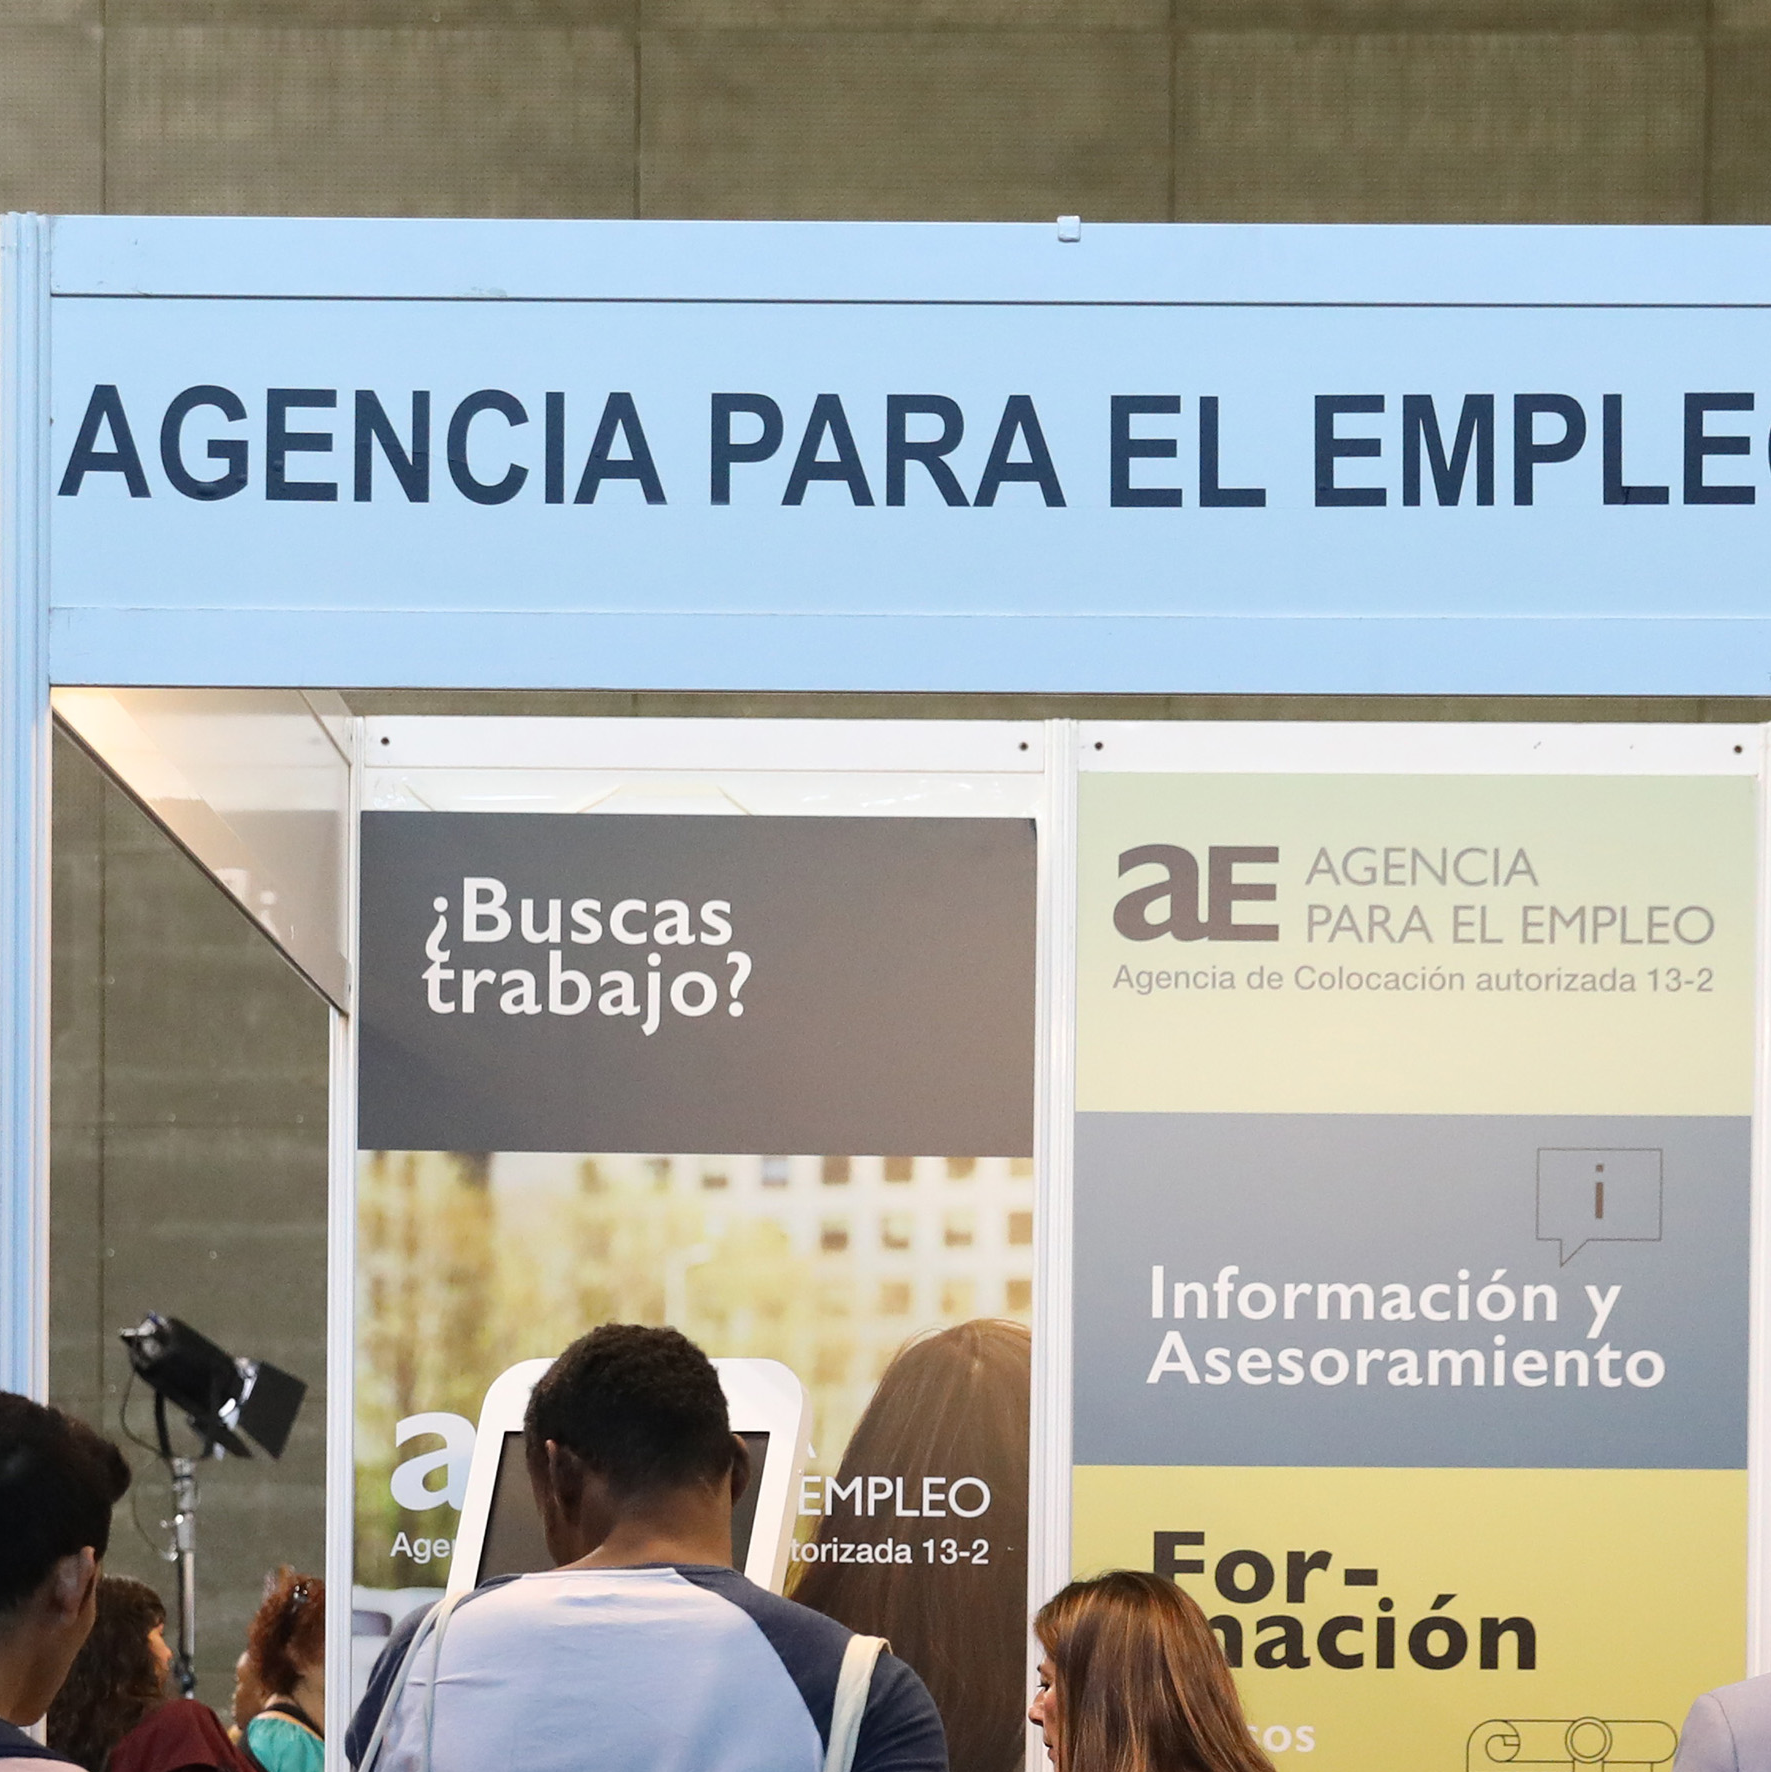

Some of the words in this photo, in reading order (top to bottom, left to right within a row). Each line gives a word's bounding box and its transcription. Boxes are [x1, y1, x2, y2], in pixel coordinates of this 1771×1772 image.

[57, 383, 668, 508] AGENCIA
[710, 392, 1069, 510] PARA
[1108, 394, 1267, 511] EL
[1112, 842, 1281, 943] aE
[1304, 846, 1541, 888] AGENCIA
[423, 876, 735, 965] ¿Buscas
[1304, 904, 1434, 946] PARA
[1451, 905, 1506, 946] EL
[1520, 904, 1716, 946] EMPLEO
[421, 950, 754, 1037] trabajo?
[1112, 964, 1237, 995] Agencia
[1246, 966, 1284, 990] de
[1293, 964, 1466, 992] Colocación
[1475, 967, 1636, 993] autorizada
[1646, 968, 1715, 993] 13-2
[1150, 1264, 1559, 1323] Información
[1584, 1282, 1623, 1340] y
[1145, 1329, 1666, 1388] Asesoramiento
[798, 1475, 992, 1518] EMPLEO
[922, 1538, 990, 1565] 13-2
[1152, 1530, 1378, 1604] For-
